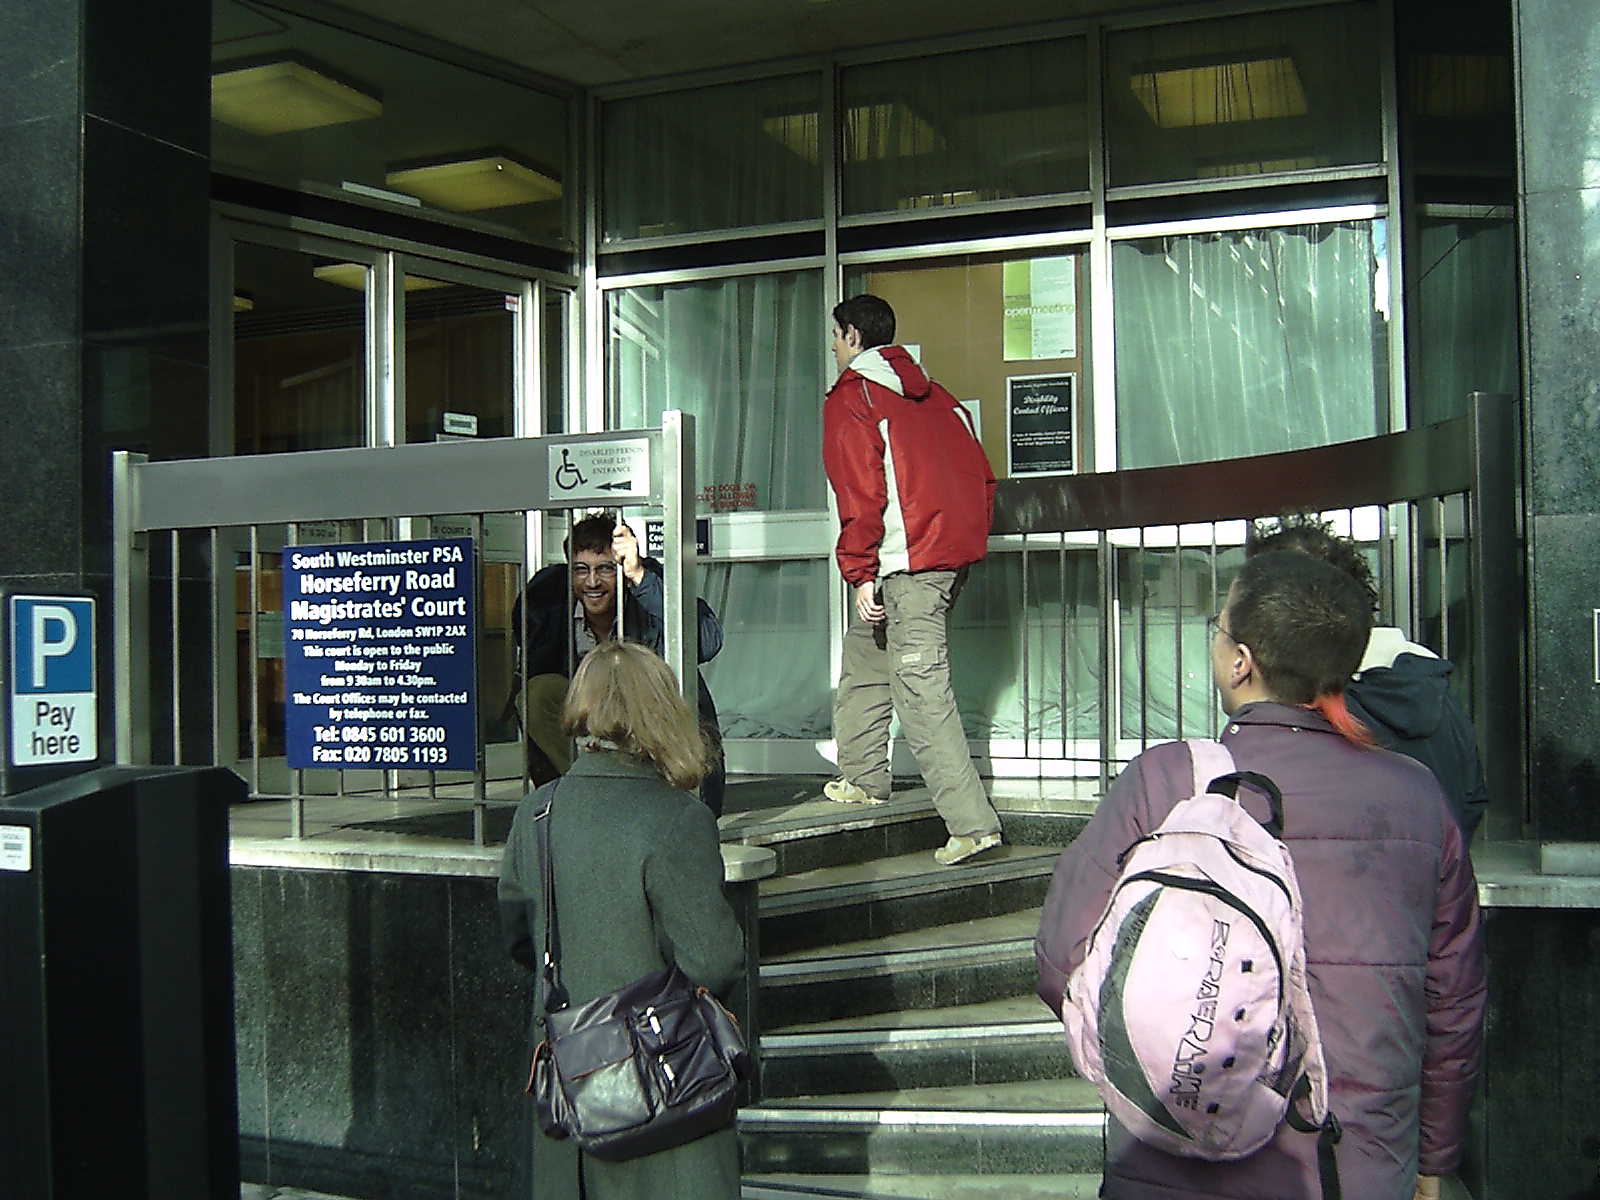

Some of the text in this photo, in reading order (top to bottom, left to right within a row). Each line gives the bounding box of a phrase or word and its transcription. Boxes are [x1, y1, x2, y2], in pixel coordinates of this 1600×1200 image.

[292, 546, 464, 570] South Westminster PSA
[300, 567, 456, 596] Horseferry Road
[290, 596, 467, 625] Magistrates' Court
[305, 627, 358, 642] Horseferry
[358, 626, 375, 640] Rd,
[375, 625, 414, 639] London
[414, 624, 444, 639] SW1P
[444, 624, 467, 637] 2AX
[31, 604, 77, 688] P
[303, 642, 455, 658] This court is open to the public
[334, 659, 422, 674] Monday to Friday
[320, 675, 346, 687] from
[383, 675, 396, 687] to
[292, 691, 468, 706] The Court Offices may be contacted
[36, 701, 76, 732] Pay
[328, 707, 343, 722] by
[343, 707, 394, 722] telephone
[395, 709, 408, 720] or
[312, 726, 446, 743] Tel: 0845 601 3600
[32, 731, 80, 756] here
[312, 746, 448, 763] Fax: 020 7805 1193
